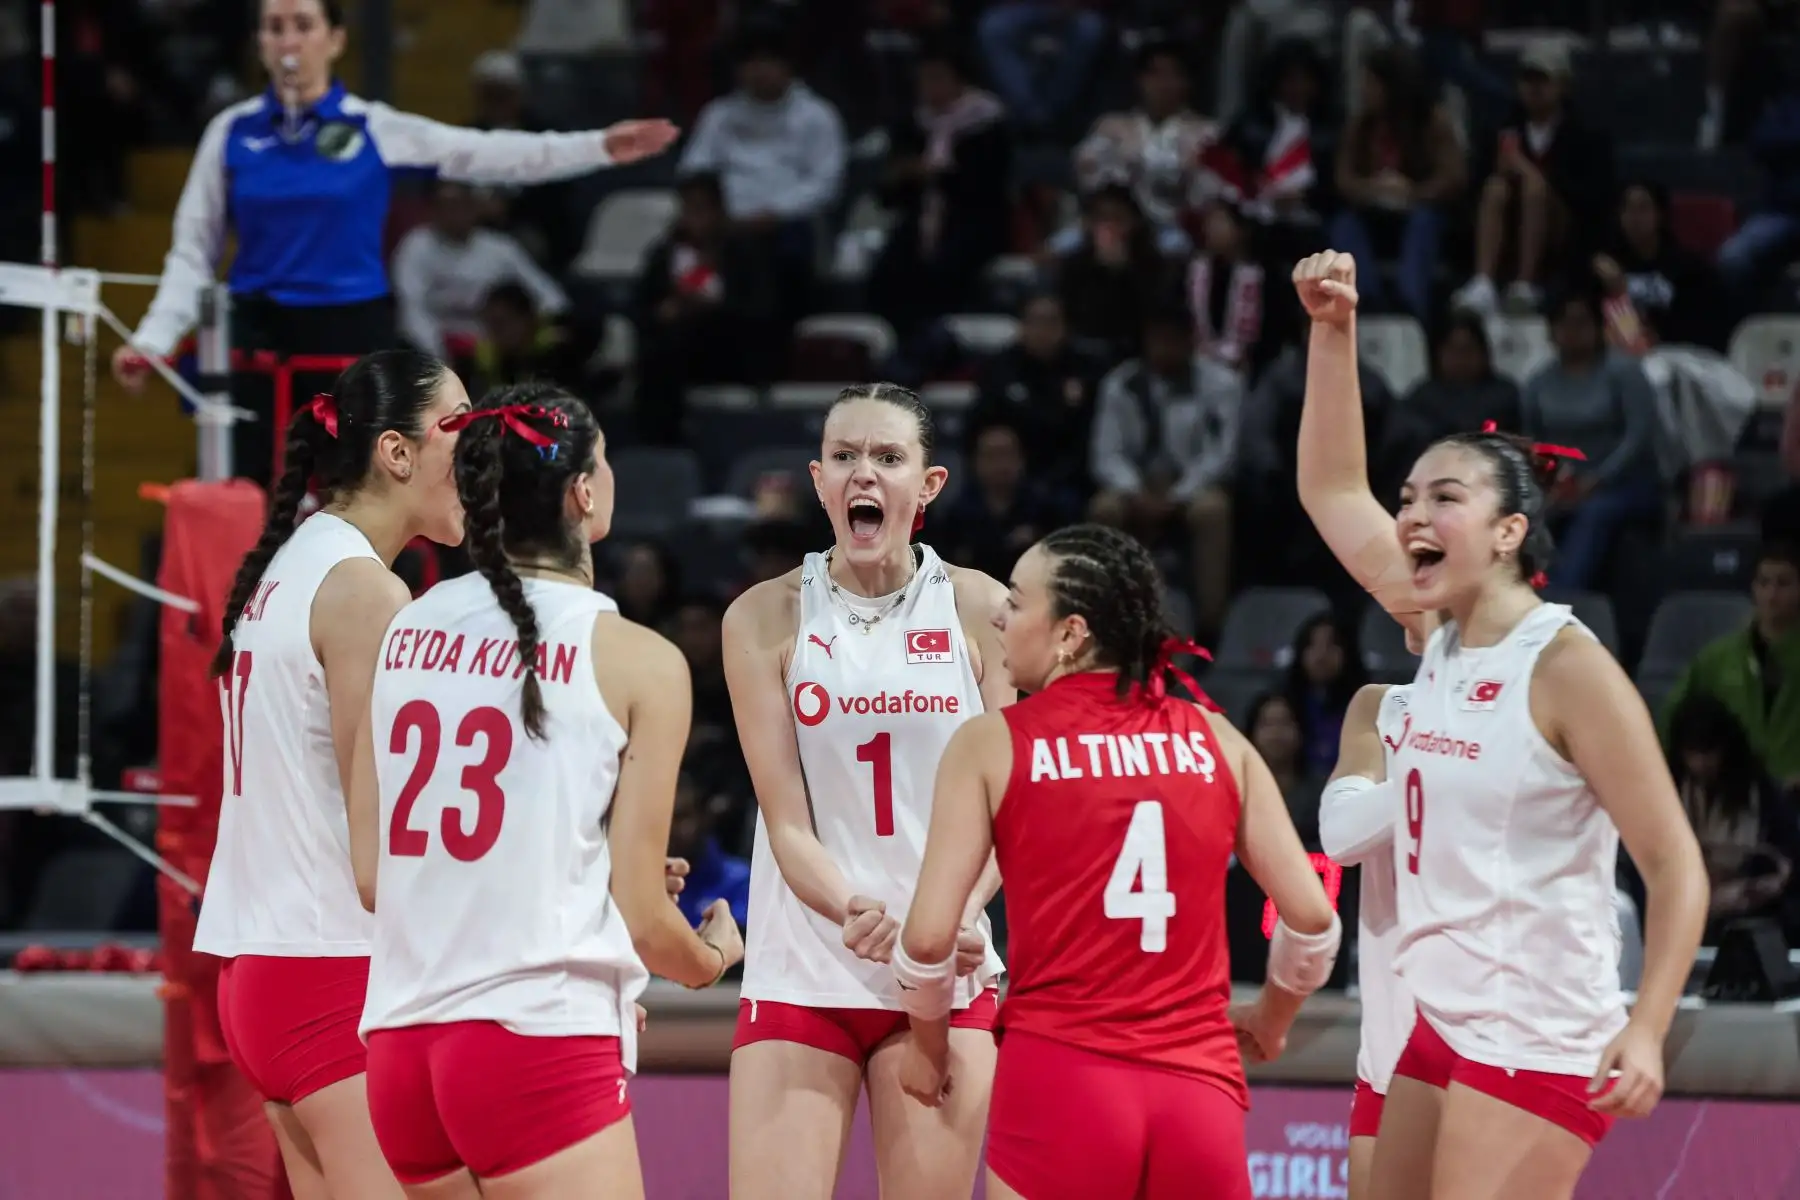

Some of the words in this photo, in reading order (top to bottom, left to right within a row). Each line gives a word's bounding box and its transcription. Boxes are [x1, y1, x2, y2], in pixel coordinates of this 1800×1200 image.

[385, 629, 465, 673] CEYDA
[917, 653, 942, 661] TUR
[838, 690, 959, 714] vodafone
[390, 699, 513, 862] 23
[856, 732, 895, 837] 1
[1031, 731, 1216, 783] ALTINTAŞ
[1406, 768, 1424, 876] 9
[1103, 800, 1176, 953] 4
